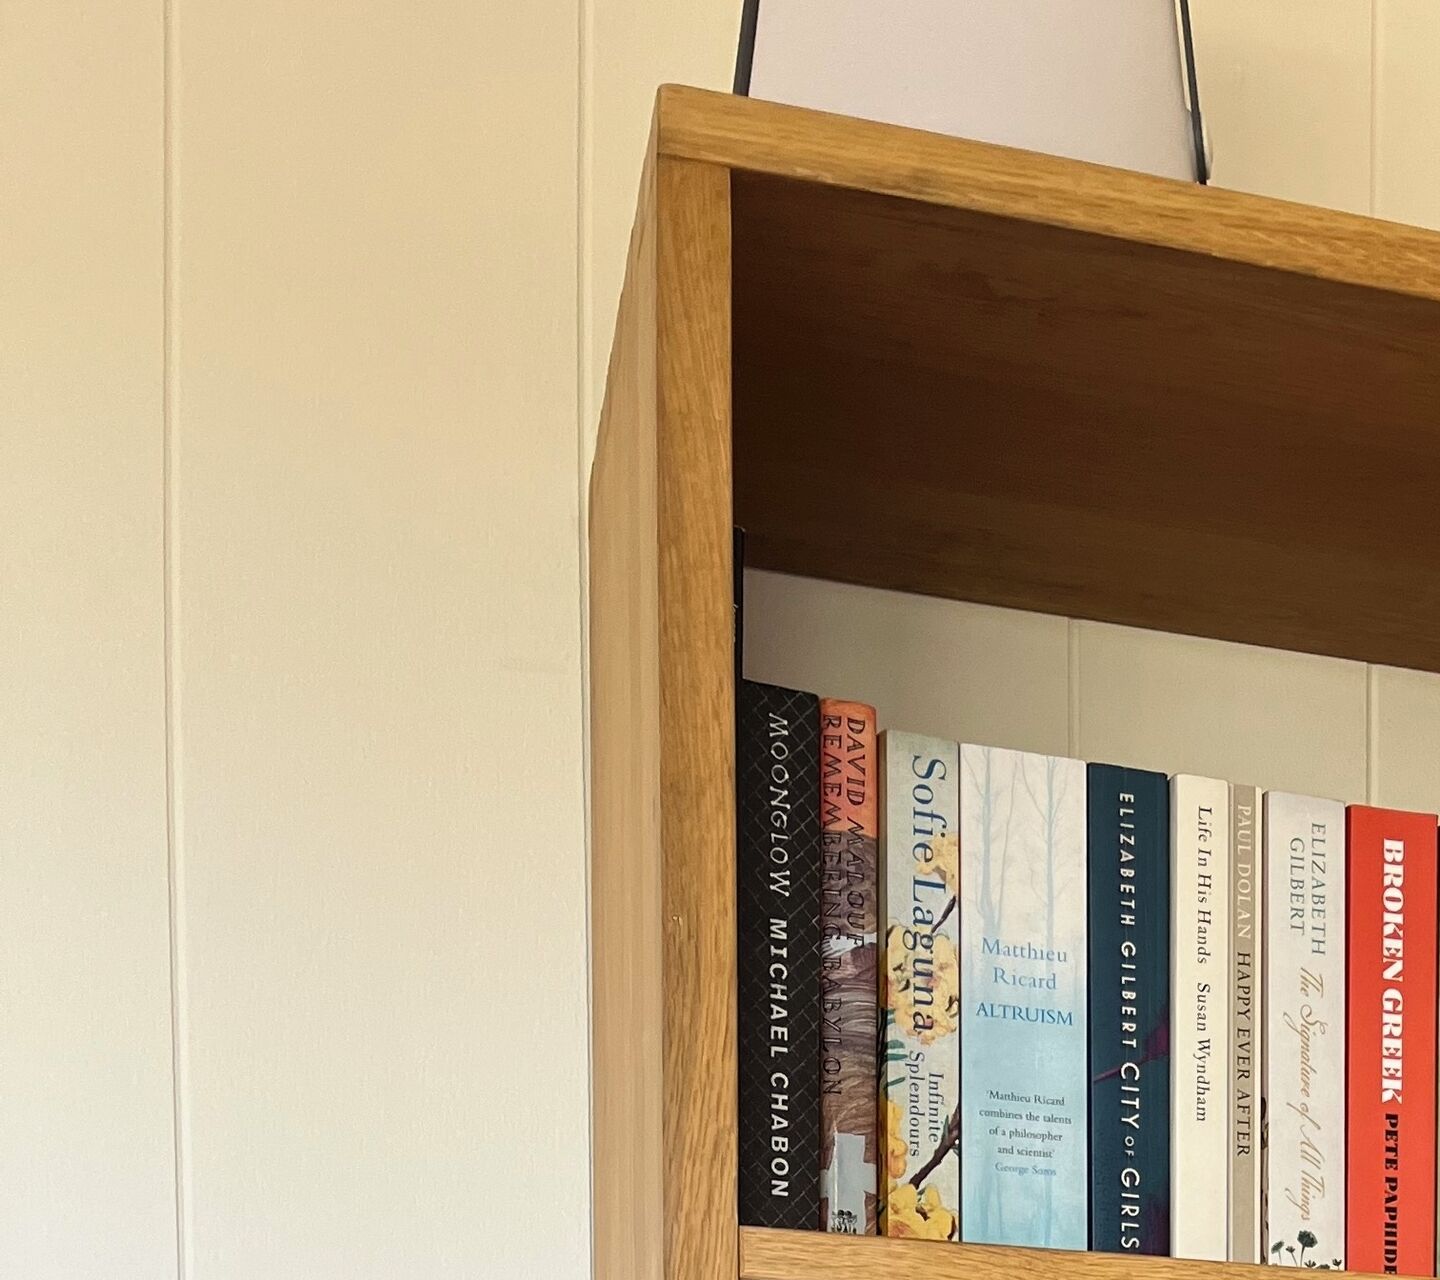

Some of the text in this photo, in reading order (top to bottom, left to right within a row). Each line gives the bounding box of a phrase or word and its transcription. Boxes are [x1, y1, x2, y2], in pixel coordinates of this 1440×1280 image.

[846, 716, 866, 806] DAVID
[903, 754, 947, 1035] Sofie Laguna
[1289, 837, 1305, 936] GILBERT
[1310, 822, 1326, 956] ELIZABETH
[769, 712, 791, 1198] MOONGLOW MICHAEL CHABON
[981, 936, 1068, 963] Matthieu
[992, 967, 1057, 991] Ricard
[1193, 805, 1213, 1122] Life In His Hands Susan Wyndham
[1237, 803, 1253, 1157] PAUL DOLAN HAPPY EVER AFTER
[976, 1002, 1074, 1026] ALTRUISM
[1119, 793, 1141, 1249] ELIZABETH GILBERT CITY OF GIRLS
[1381, 838, 1405, 1170] BROKEN GREEK PETE
[904, 1049, 926, 1158] Splendours
[928, 1072, 945, 1143] Infinite
[979, 1107, 1023, 1121] combines
[1008, 1126, 1063, 1143] philosopher
